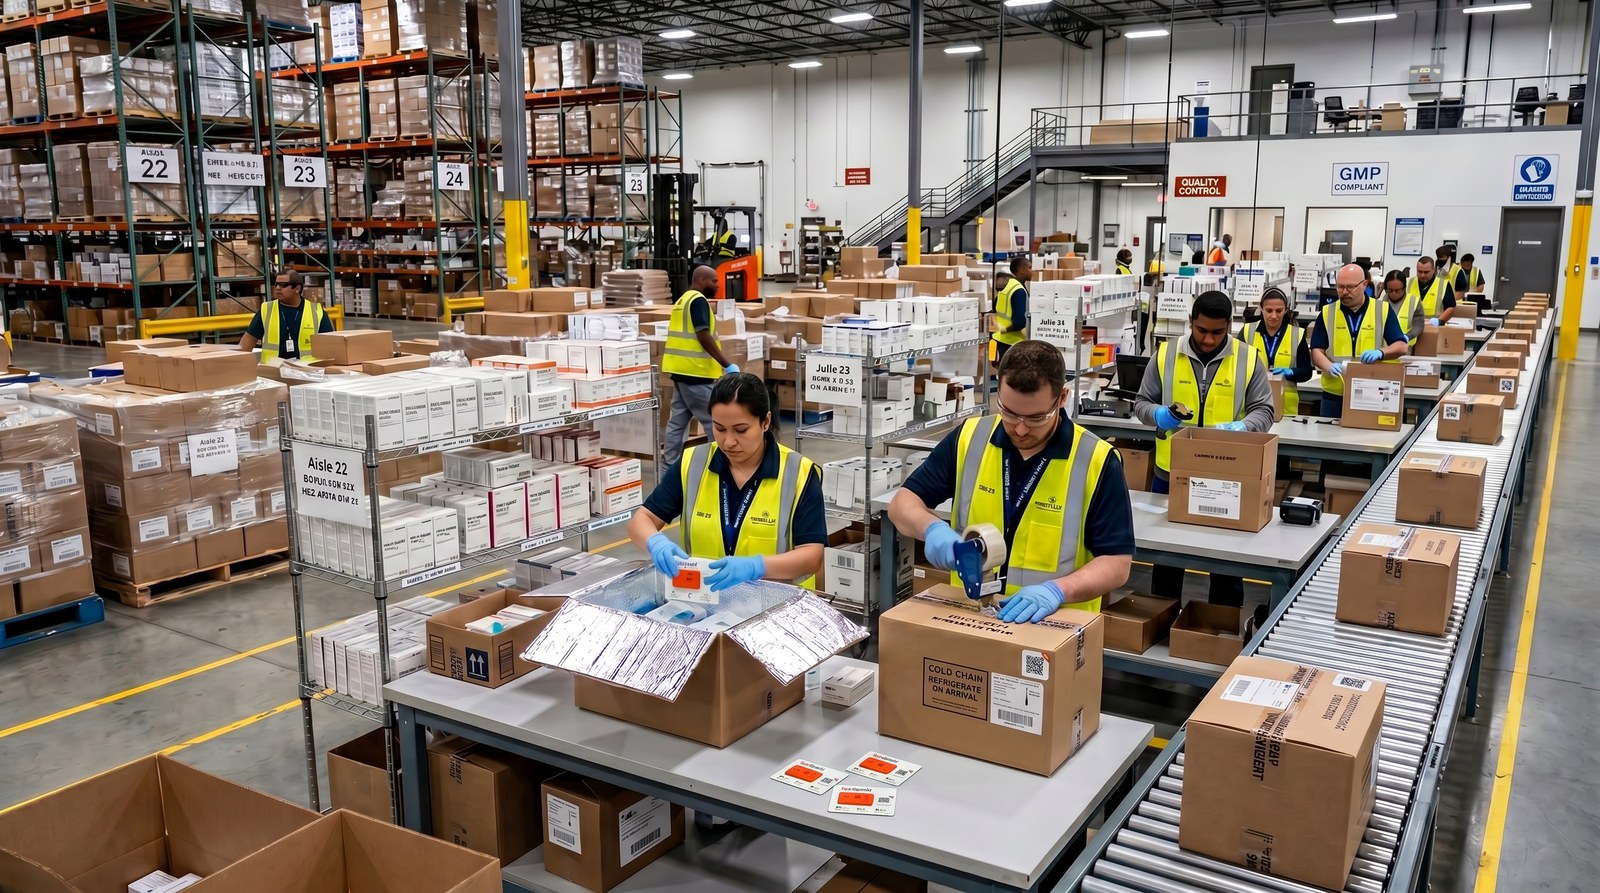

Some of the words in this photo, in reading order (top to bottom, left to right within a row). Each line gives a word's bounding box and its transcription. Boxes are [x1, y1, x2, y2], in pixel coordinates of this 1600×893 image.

[141, 158, 169, 178] 22
[294, 165, 315, 182] 23
[1339, 166, 1381, 181] GMP
[446, 171, 464, 186] 24
[631, 179, 643, 192] 23
[1181, 178, 1219, 187] QUALITY
[1178, 186, 1221, 195] CONTROL
[1334, 183, 1385, 191] COMPLIANT
[839, 365, 851, 375] 23
[217, 436, 225, 444] 22
[307, 456, 333, 473] Aisle
[335, 461, 348, 476] 22
[928, 664, 953, 676] COLD
[955, 670, 983, 684] CHAIN
[928, 675, 982, 694] REFRIGERATE
[932, 685, 944, 693] ON
[945, 688, 979, 702] ARRIVAL
